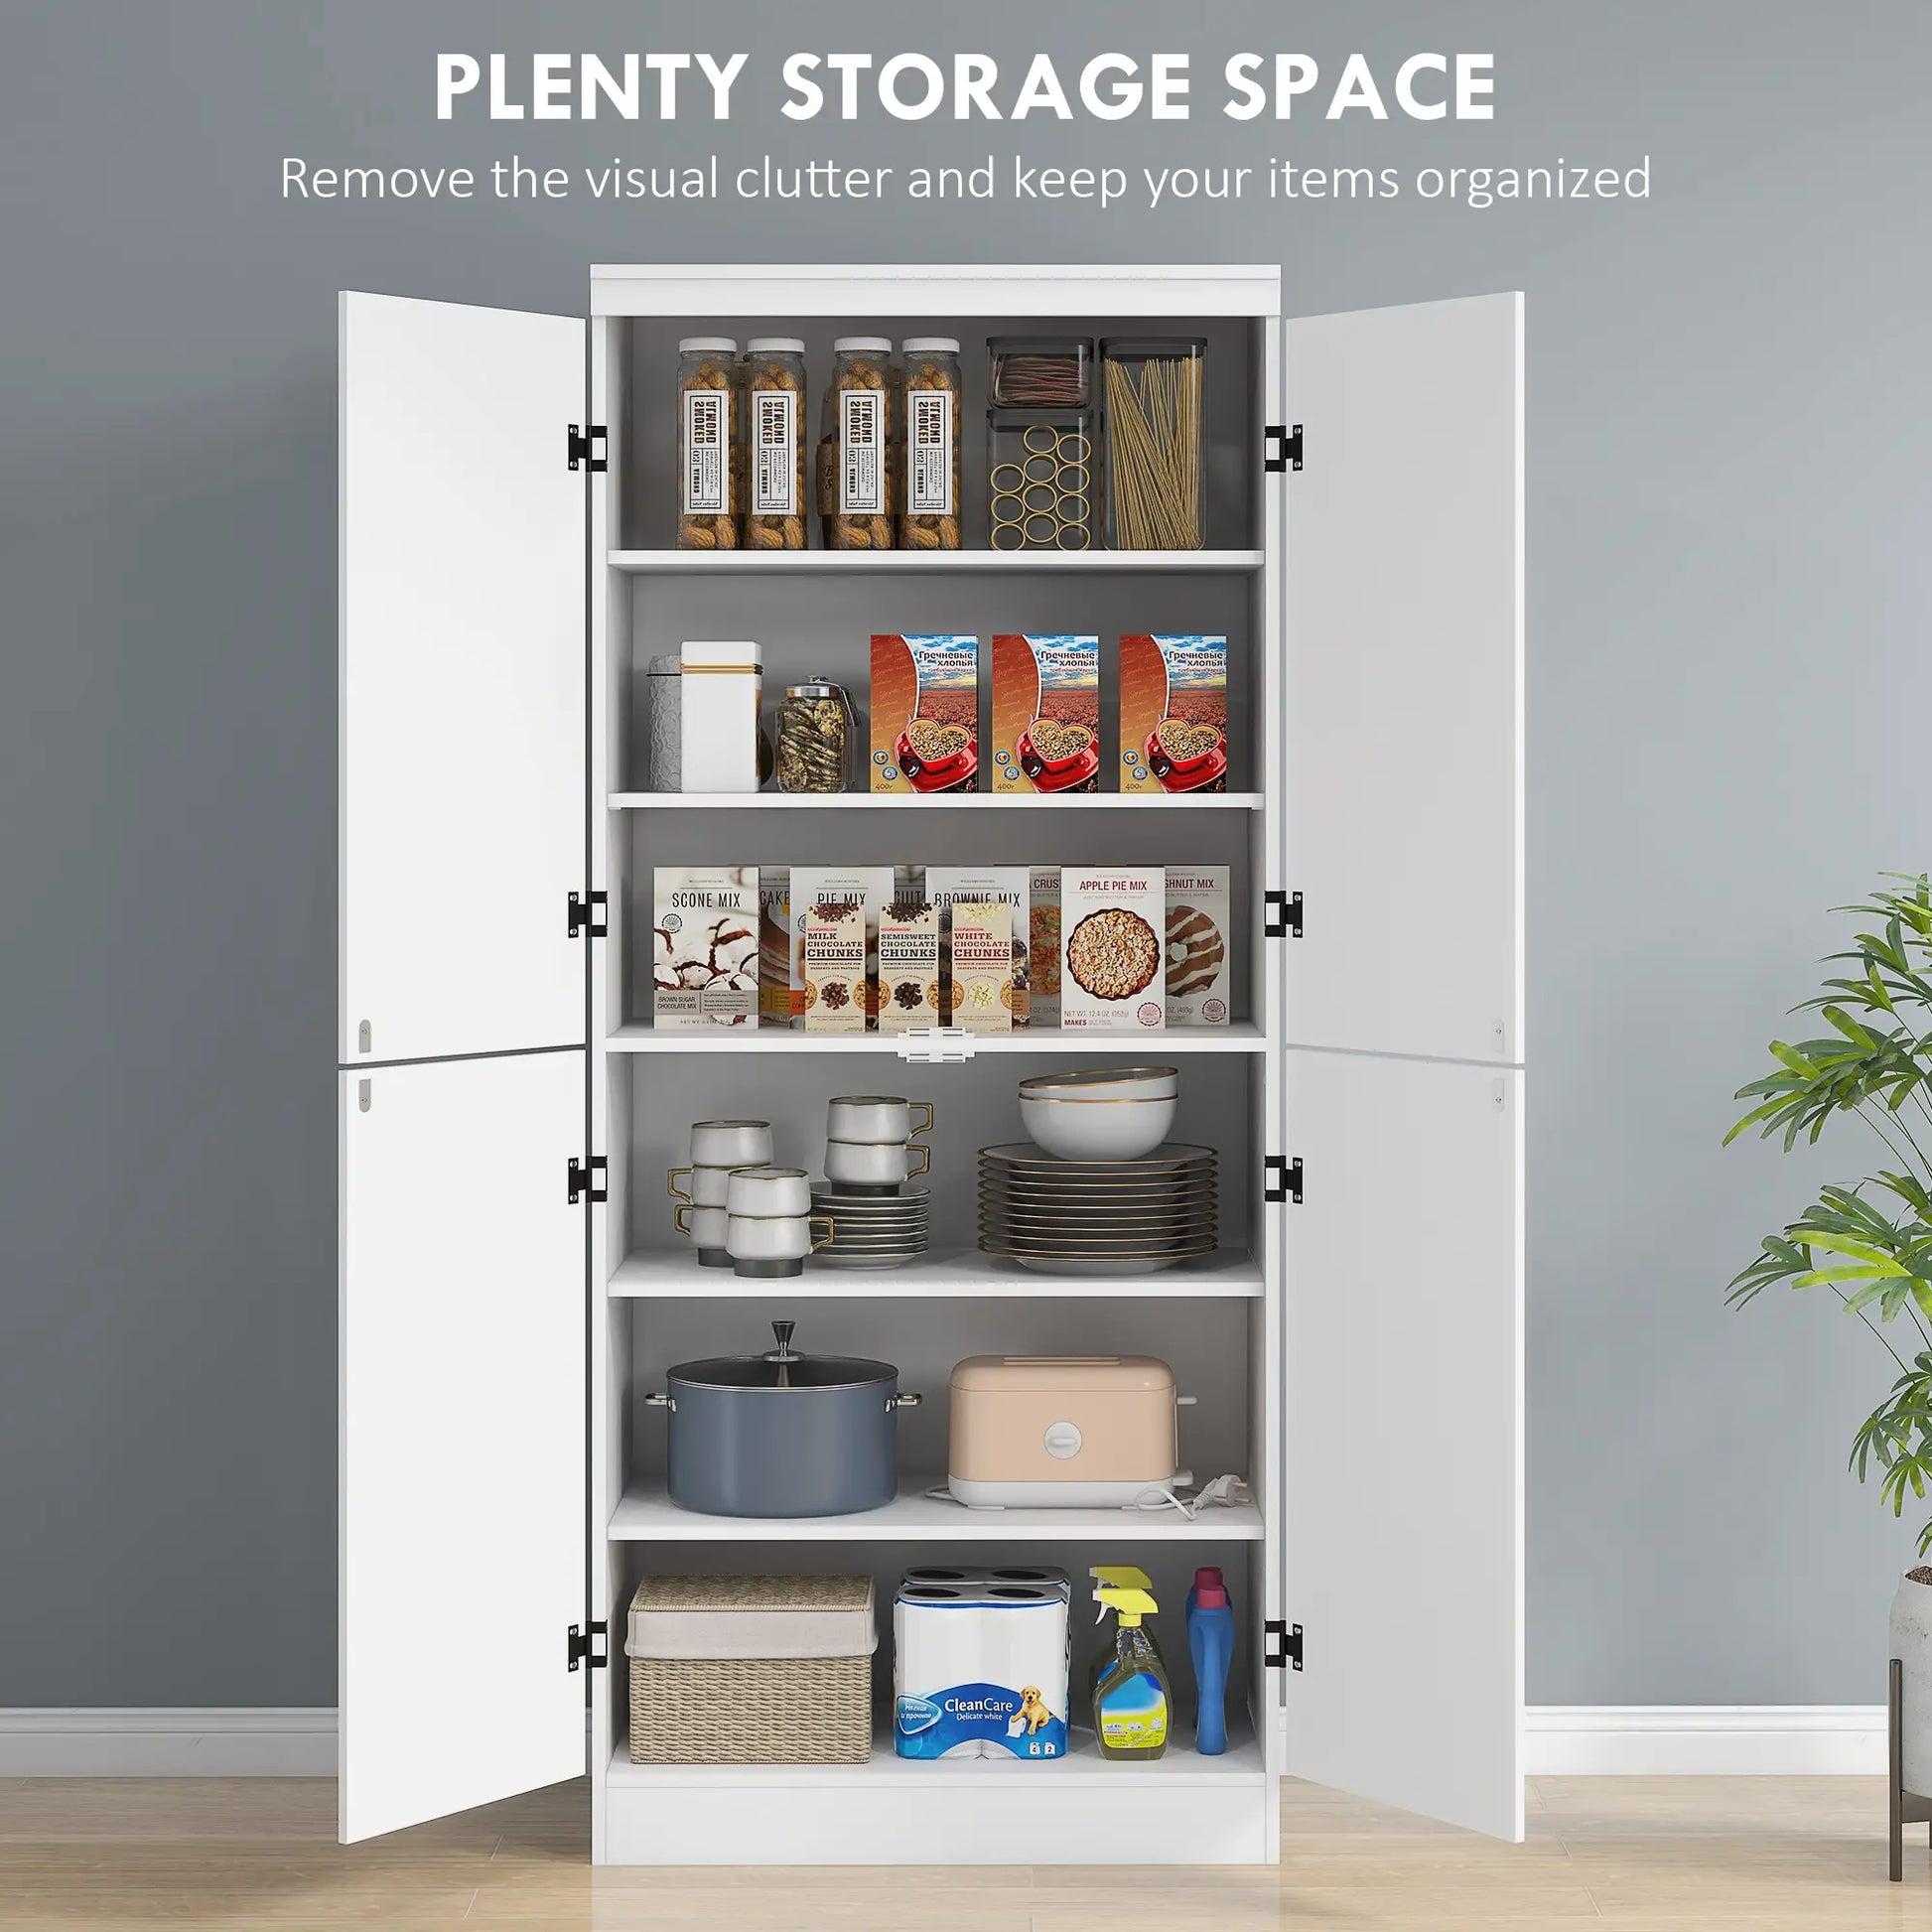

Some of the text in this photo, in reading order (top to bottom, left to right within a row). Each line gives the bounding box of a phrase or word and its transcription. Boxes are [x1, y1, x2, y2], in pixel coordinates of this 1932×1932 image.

[918, 651, 973, 661] Гречневые
[1040, 651, 1095, 661] Гречневые
[1169, 651, 1222, 661] Гречневые
[1034, 879, 1061, 889] CRUS
[1079, 881, 1148, 891] APPLE PIE MIX
[1196, 879, 1214, 889] MIX
[672, 893, 741, 907] SCONE MIX
[844, 893, 866, 905] MIX
[935, 893, 1021, 907] BROWNIE MIX
[807, 948, 863, 957] CHUNKS
[881, 948, 936, 957] CHUNKS
[954, 948, 1010, 957] CHUNKS
[944, 1698, 1014, 1713] CleanCare
